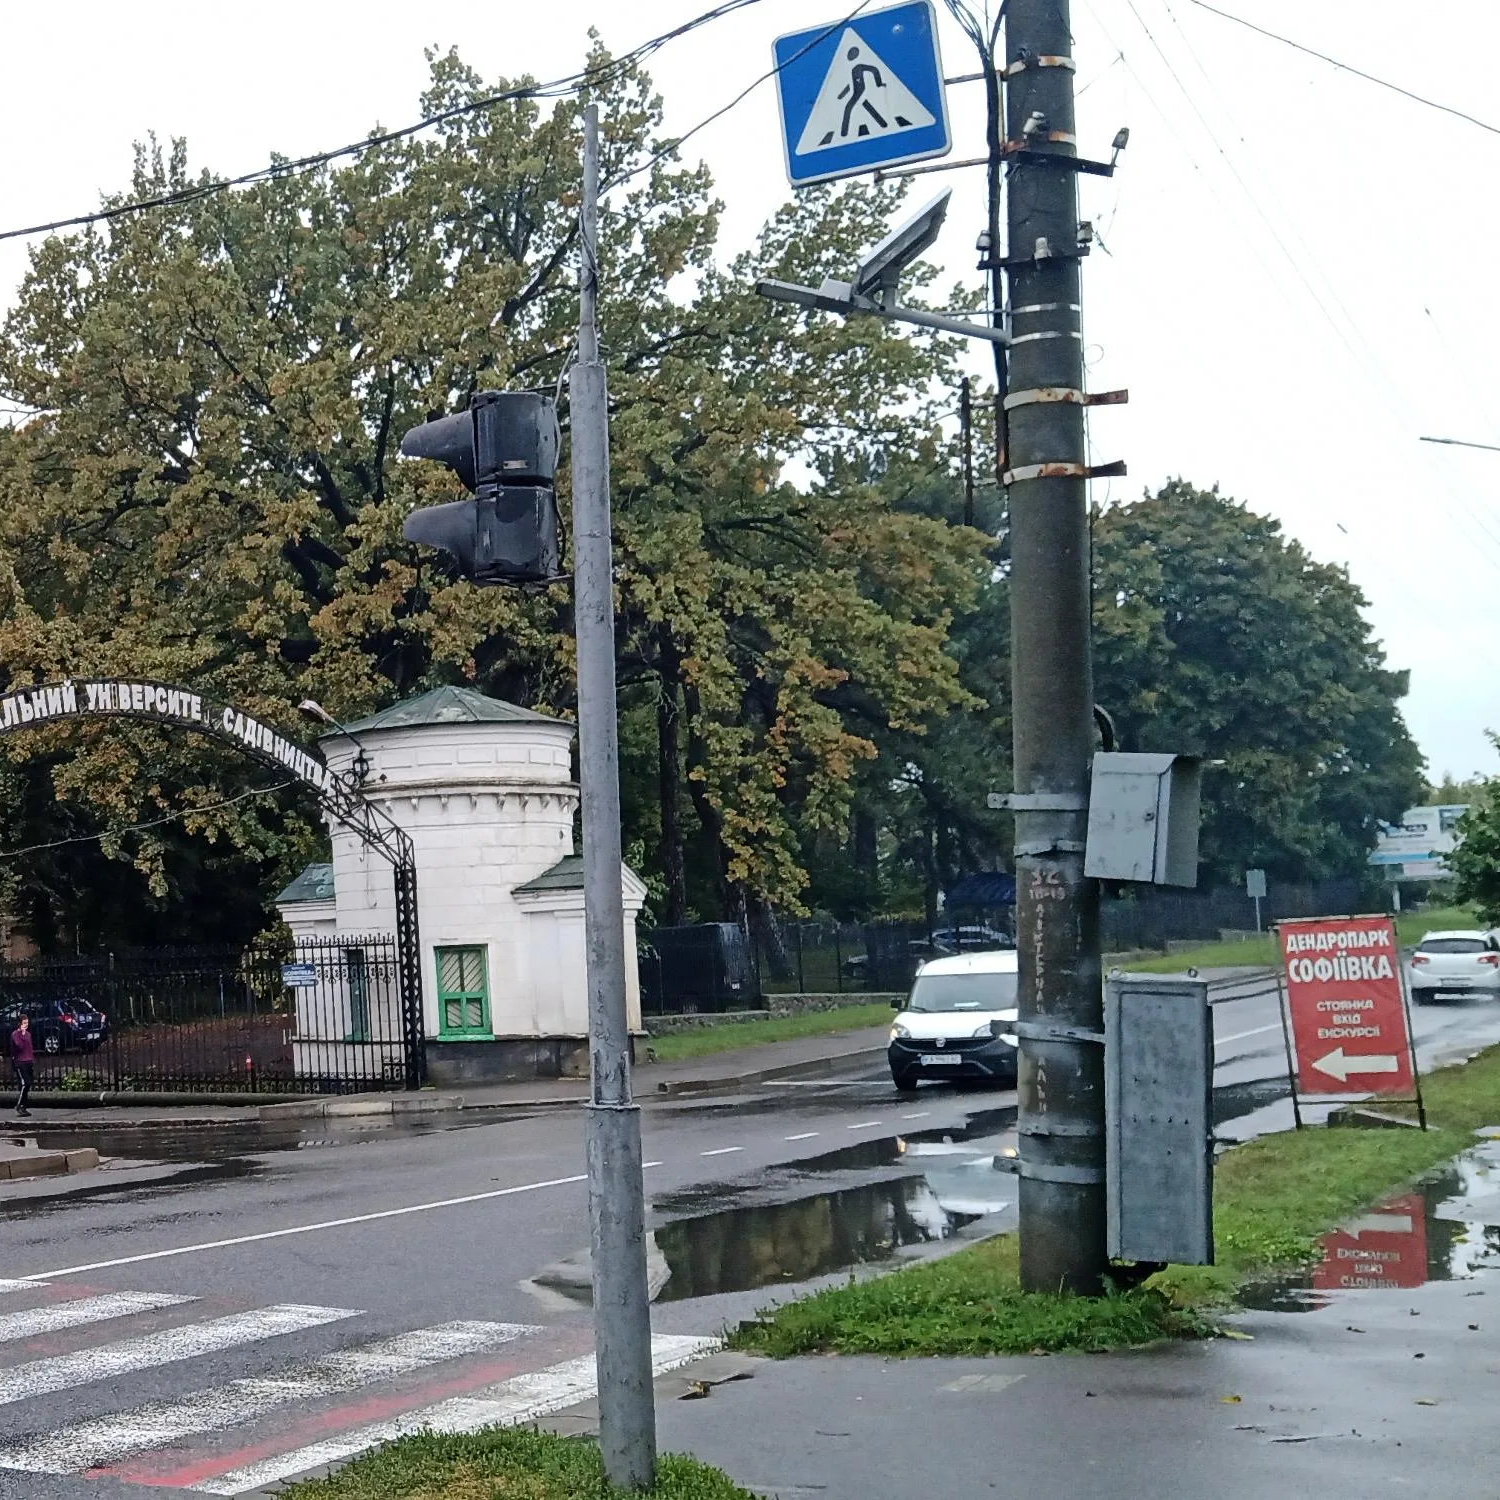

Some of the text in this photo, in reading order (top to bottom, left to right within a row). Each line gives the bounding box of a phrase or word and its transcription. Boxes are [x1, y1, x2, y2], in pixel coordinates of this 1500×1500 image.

[222, 707, 336, 797] САДІВНИЦТВА
[1286, 930, 1391, 953] ДЕНДРОПАРК
[1288, 953, 1394, 983] СОФІЇВКА
[1316, 1000, 1374, 1011] СТОЯНКА
[1332, 1013, 1361, 1024] ВХІД
